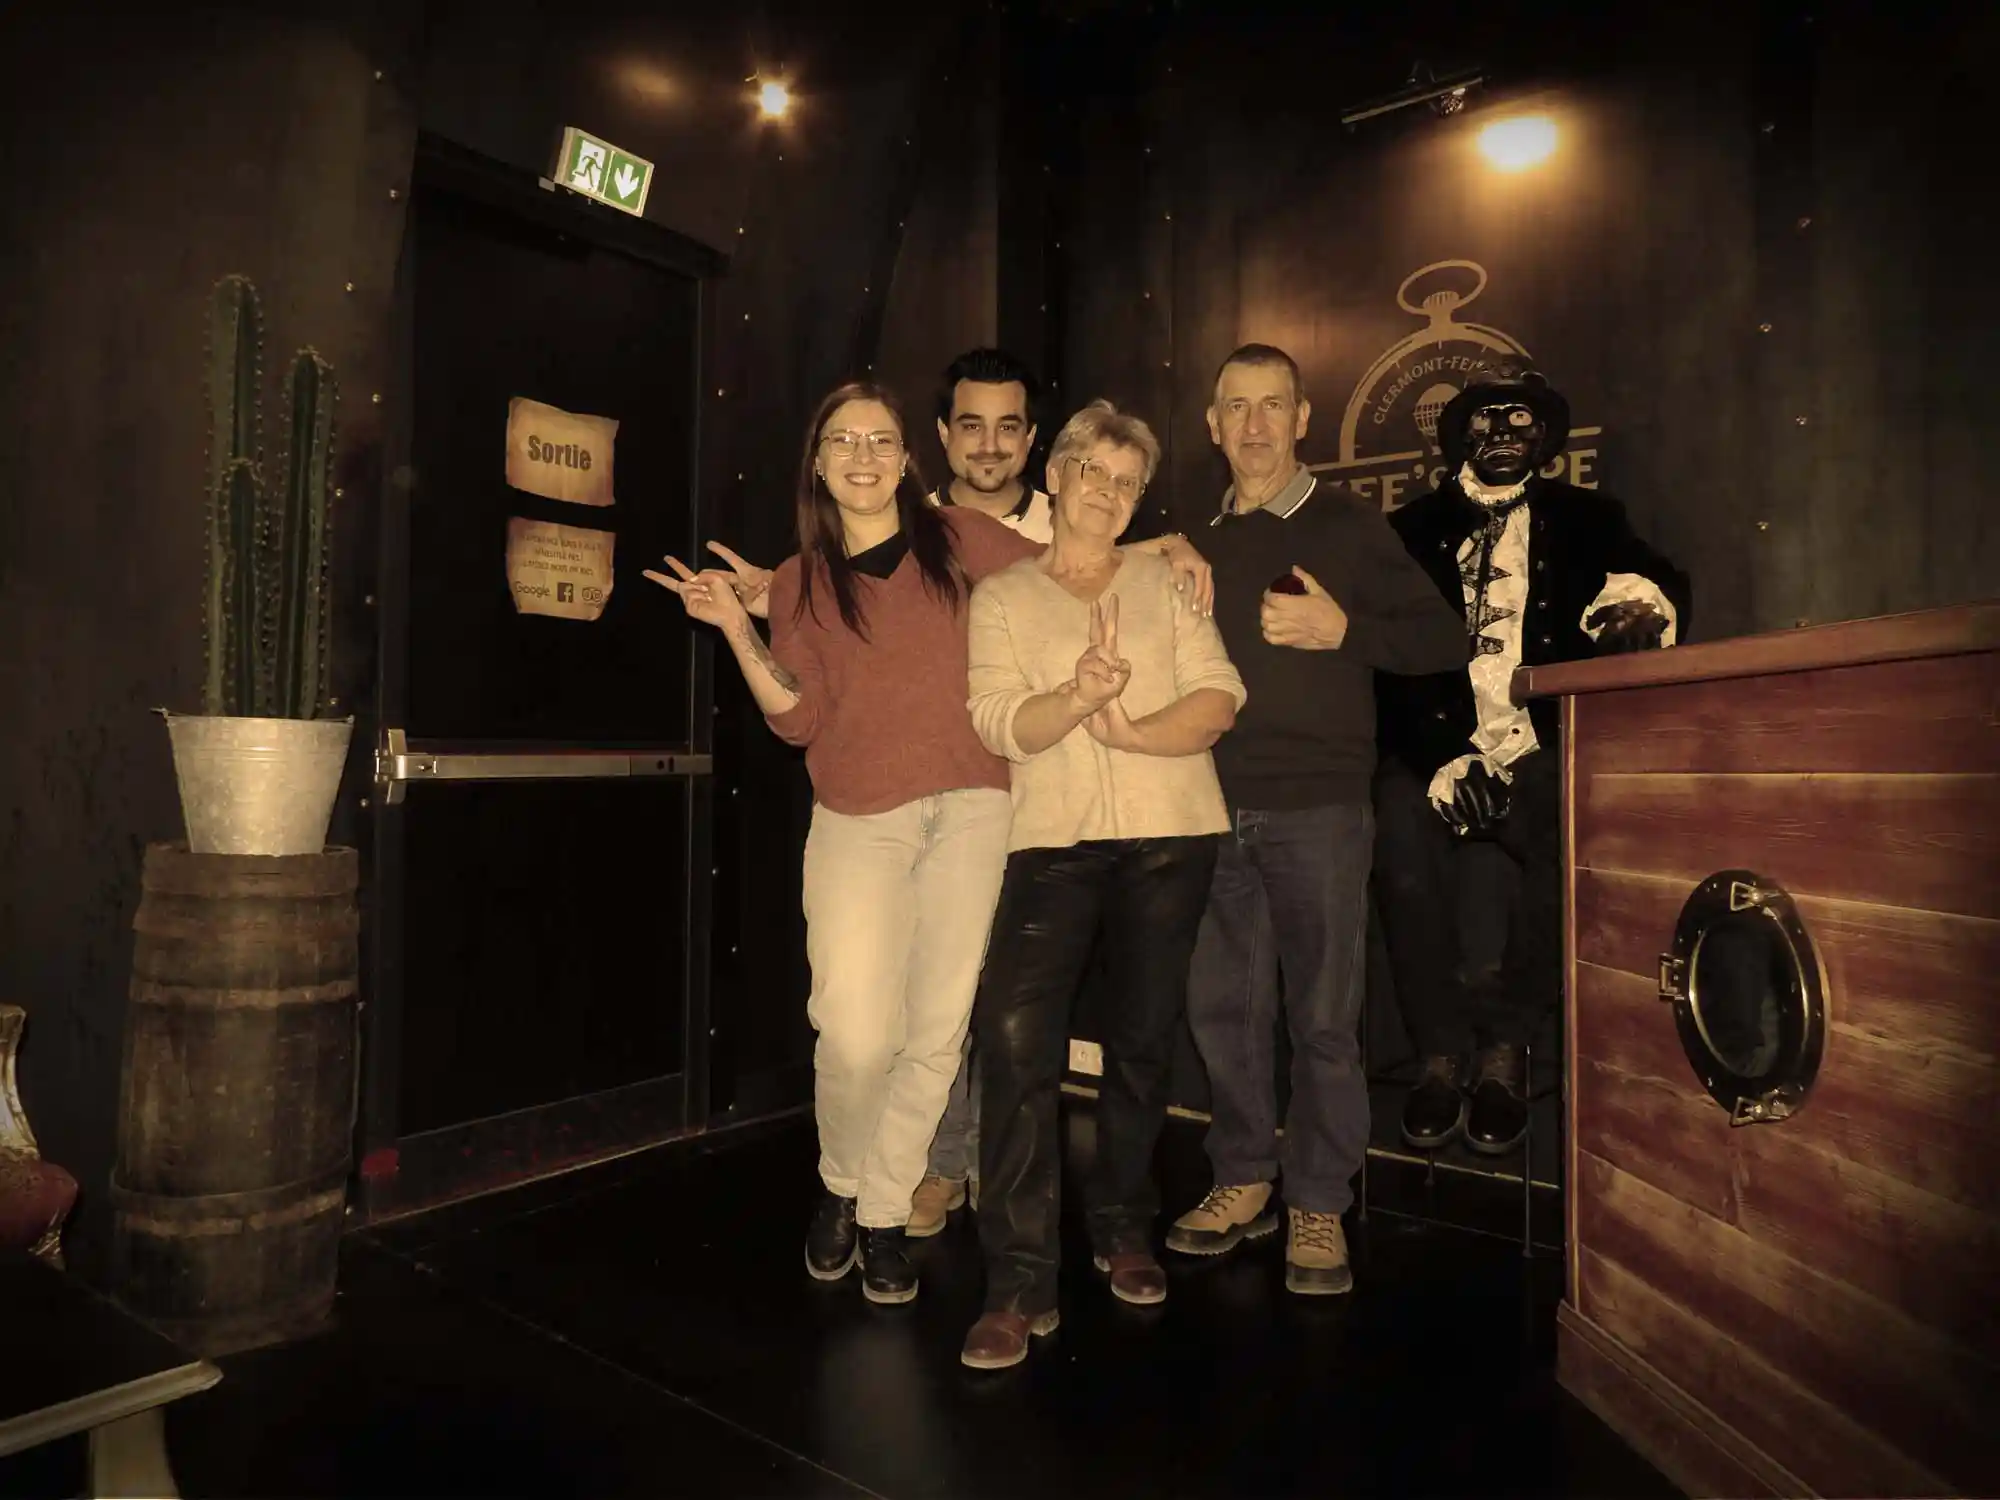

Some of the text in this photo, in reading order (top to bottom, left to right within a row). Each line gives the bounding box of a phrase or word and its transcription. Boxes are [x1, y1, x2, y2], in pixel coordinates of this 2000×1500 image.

[1373, 356, 1479, 424] CLERMONT-FE
[528, 435, 591, 471] Sortie
[515, 581, 550, 598] Google
